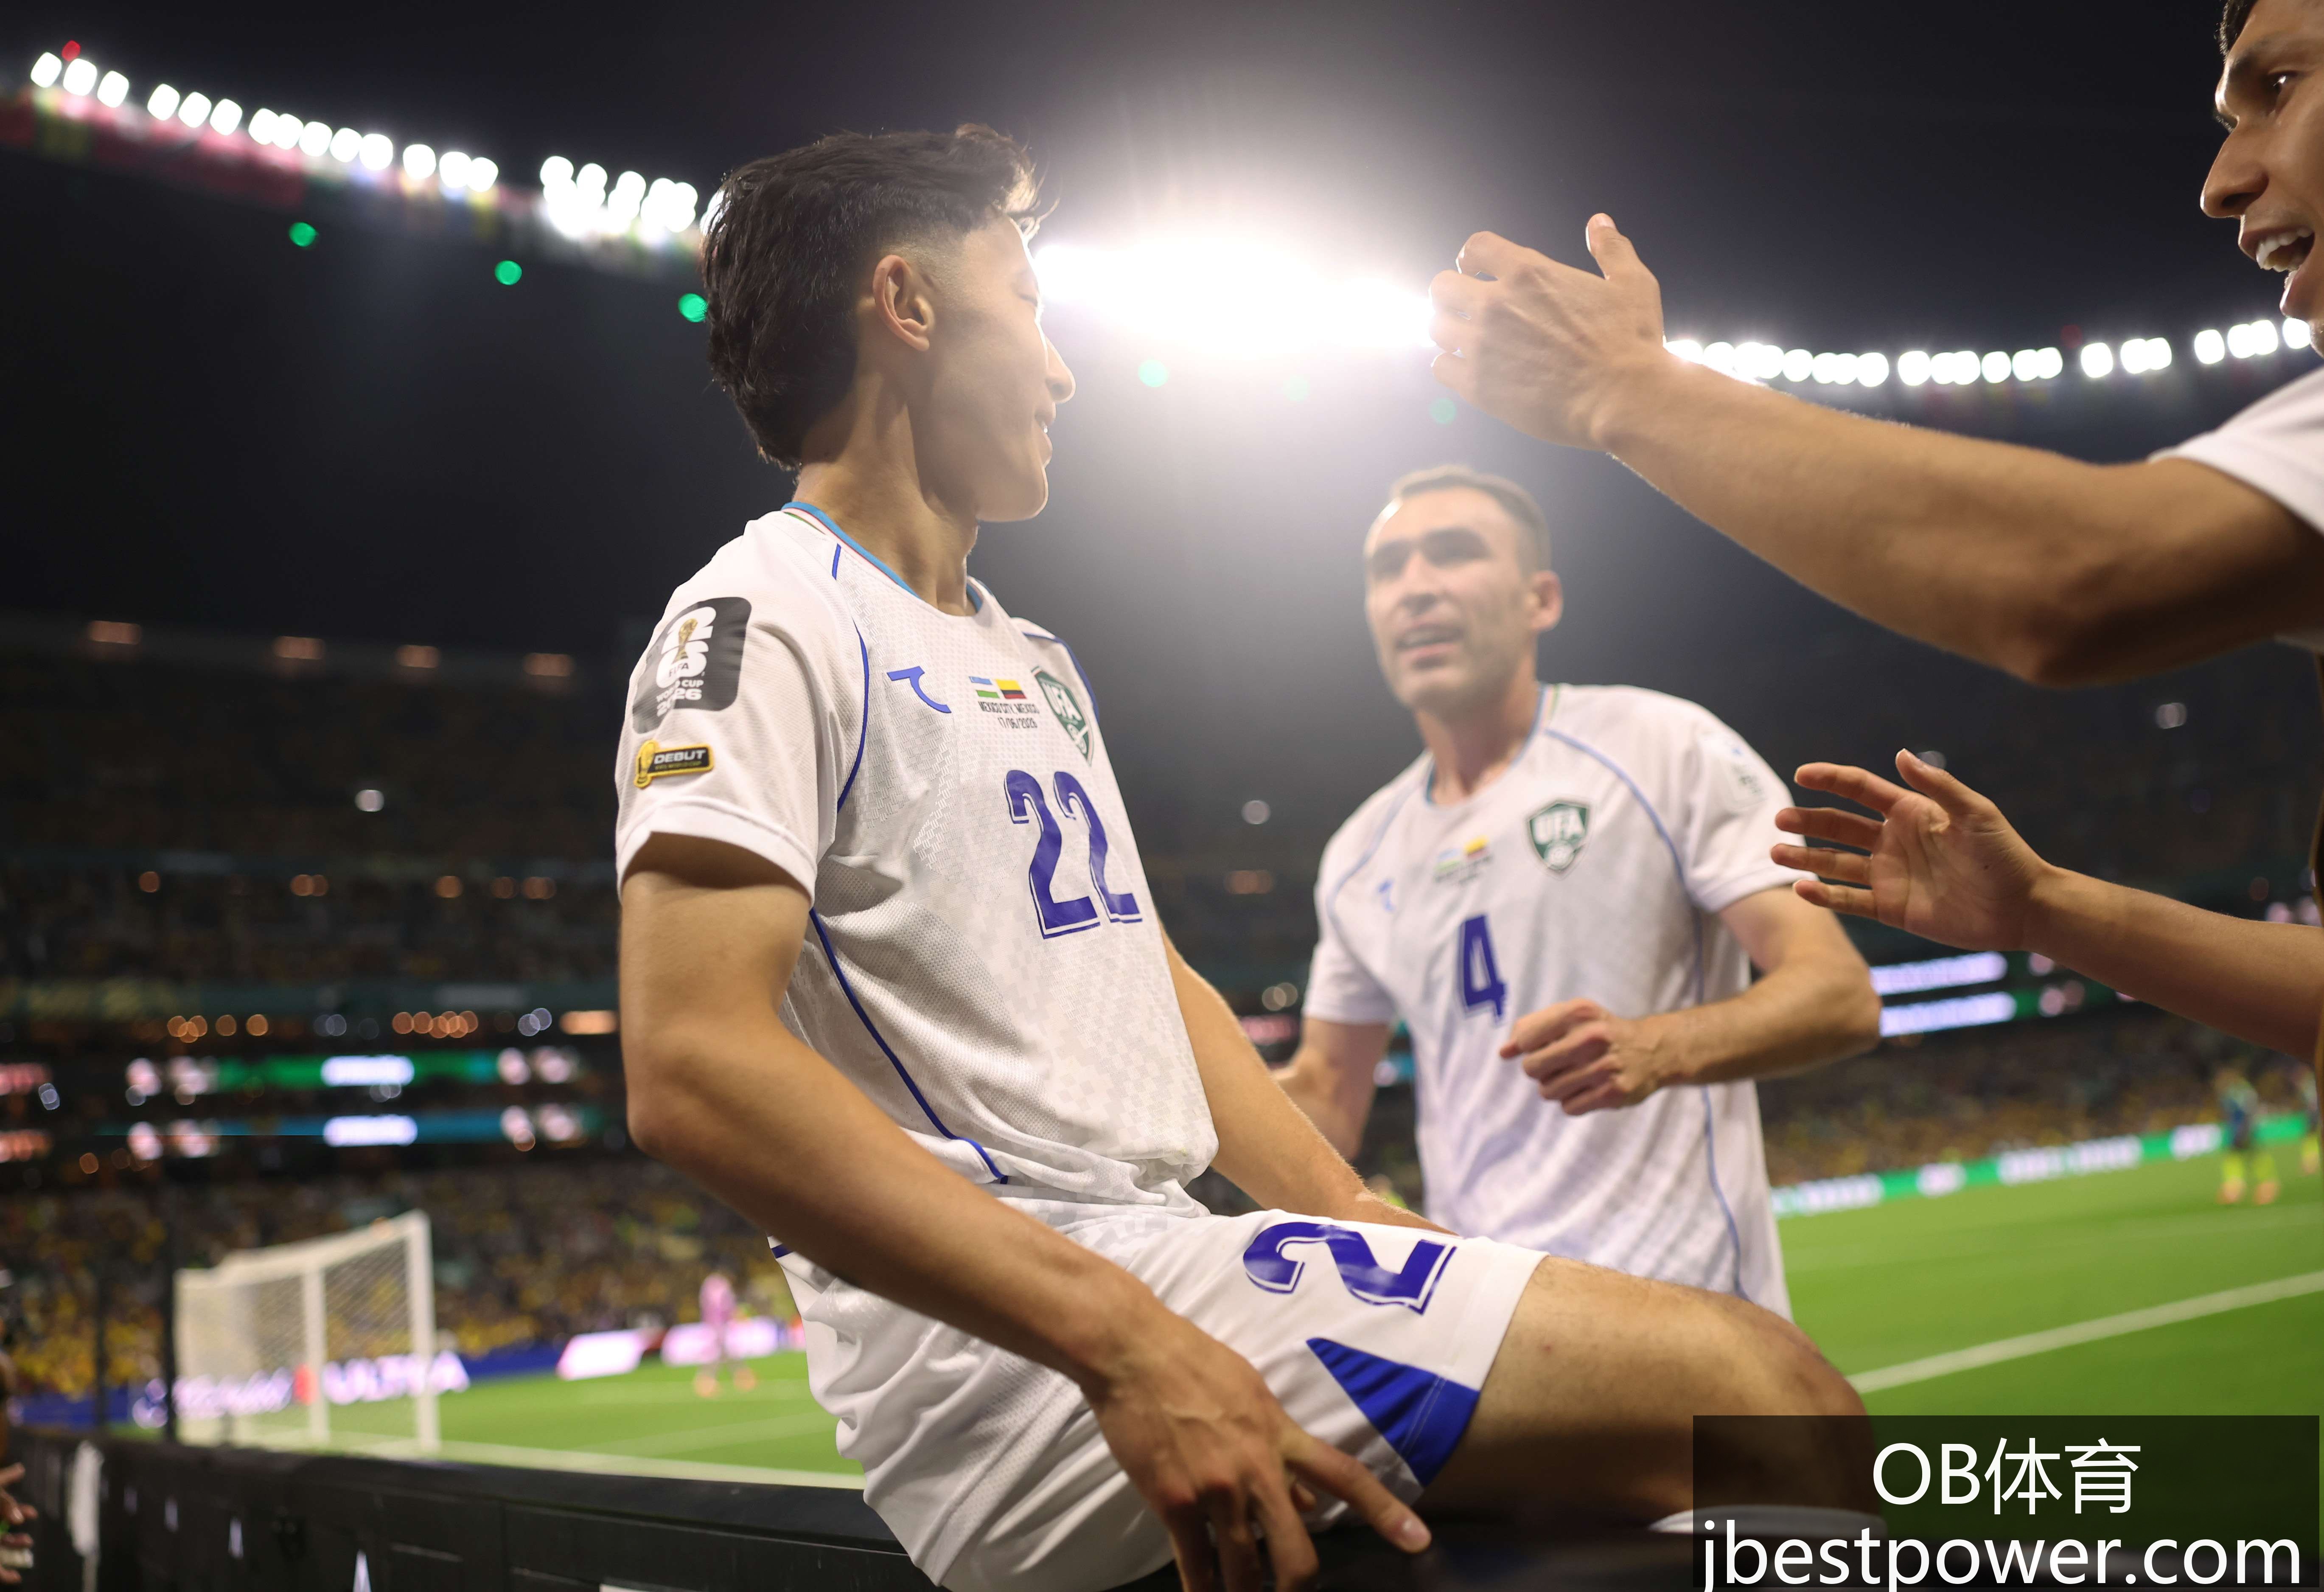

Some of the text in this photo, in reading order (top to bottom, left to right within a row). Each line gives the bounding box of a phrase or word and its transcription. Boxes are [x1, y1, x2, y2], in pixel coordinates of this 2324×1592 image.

[656, 679, 704, 702] WORD CUP
[978, 701, 1002, 713] MEXICO
[654, 750, 706, 764] DEBUT
[1533, 807, 1586, 844] UFA
[1004, 770, 1142, 939] 22
[1458, 914, 1508, 1024] 4
[1243, 1221, 1458, 1315] 2
